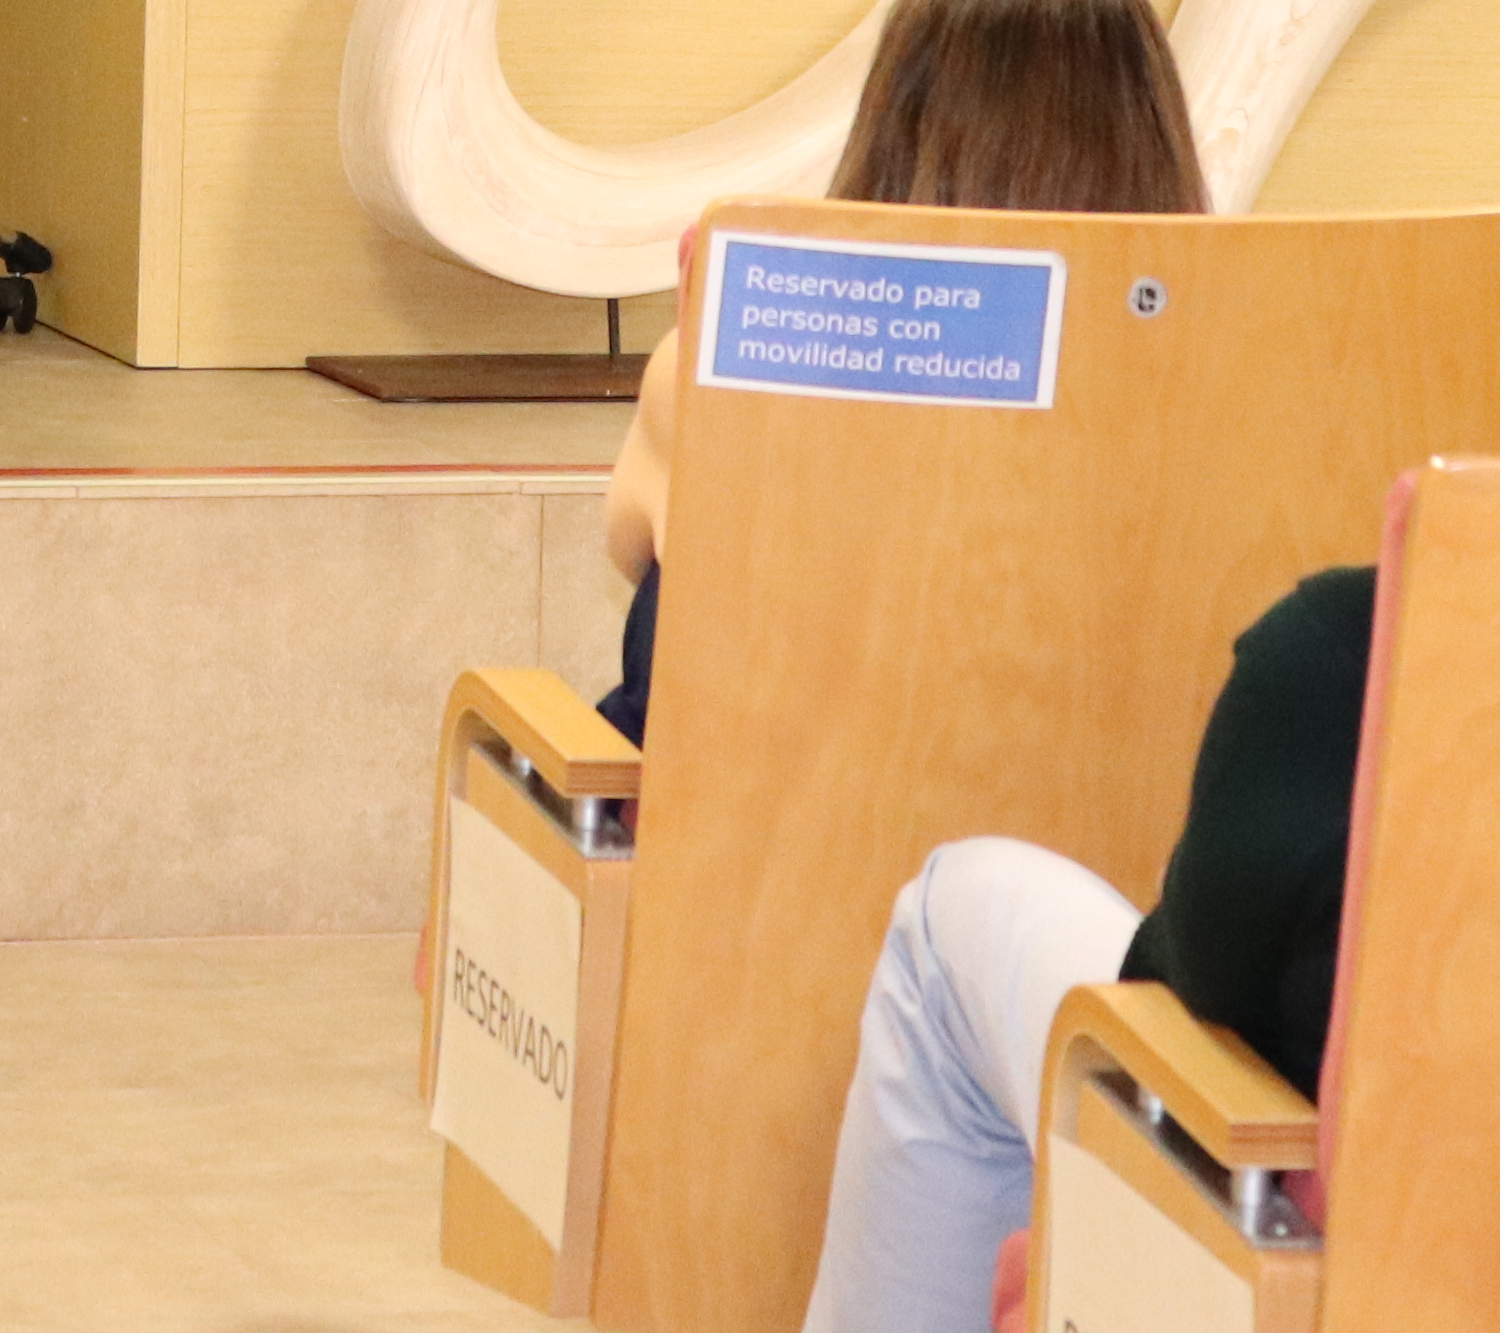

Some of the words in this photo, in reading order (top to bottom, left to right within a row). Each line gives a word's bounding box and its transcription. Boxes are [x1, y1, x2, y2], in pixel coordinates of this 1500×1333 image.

[746, 264, 903, 304] Reservado
[914, 285, 981, 311] para
[742, 304, 878, 338] personas
[888, 315, 940, 341] con
[738, 337, 883, 373] movilidad
[894, 350, 1021, 381] reducida
[454, 947, 568, 1101] RESERVADO
